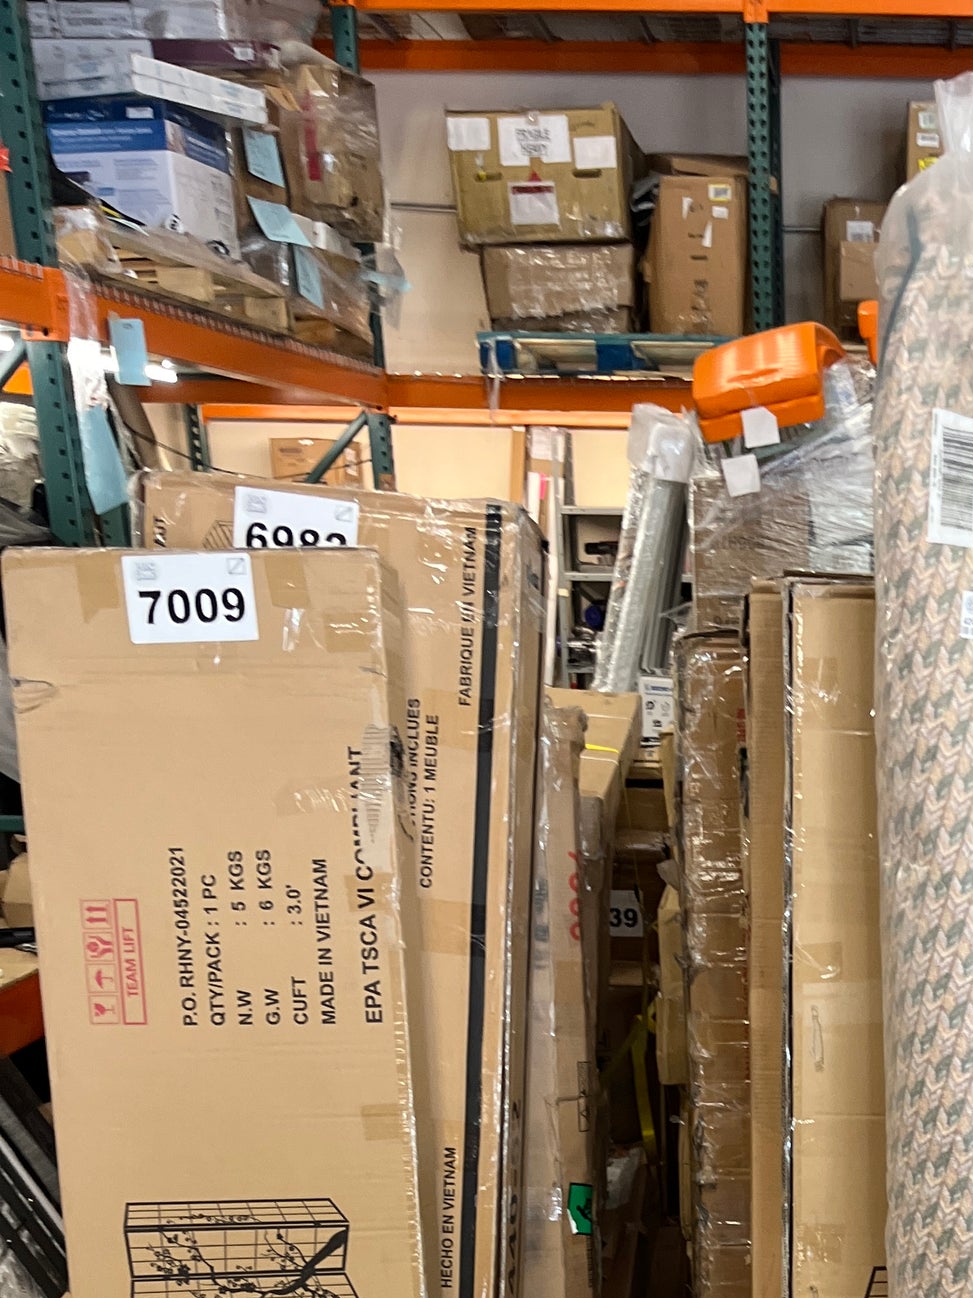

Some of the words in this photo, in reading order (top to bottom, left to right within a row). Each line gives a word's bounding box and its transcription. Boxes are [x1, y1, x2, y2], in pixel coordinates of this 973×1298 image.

[462, 527, 477, 596] VIETNAM
[138, 588, 246, 625] 7009
[457, 628, 474, 706] FABRIQUE
[424, 715, 439, 781] MEUBLE
[420, 798, 435, 888] CONTENTU:
[201, 874, 217, 899] PC
[227, 850, 244, 890] KGS
[255, 849, 272, 889] KGS
[168, 846, 195, 987] RHNY-04522021
[204, 907, 217, 915] 1
[232, 902, 246, 912] 5
[260, 900, 273, 911] 6
[312, 859, 331, 942] VIETNAM
[357, 888, 375, 908] VI
[121, 926, 135, 953] LIFT
[318, 948, 332, 966] IN
[359, 915, 380, 974] TSCA
[124, 958, 140, 997] TEAM
[204, 932, 226, 1026] QTY/PACK
[183, 992, 198, 1026] P.O.
[236, 990, 252, 1025] N.W
[265, 988, 280, 1025] G.W
[292, 977, 308, 1024] CUFT
[319, 972, 336, 1024] MADE
[365, 981, 383, 1023] EPA
[443, 1147, 456, 1210] VIETNAM
[442, 1215, 454, 1233] EN
[440, 1239, 453, 1288] HECHO
